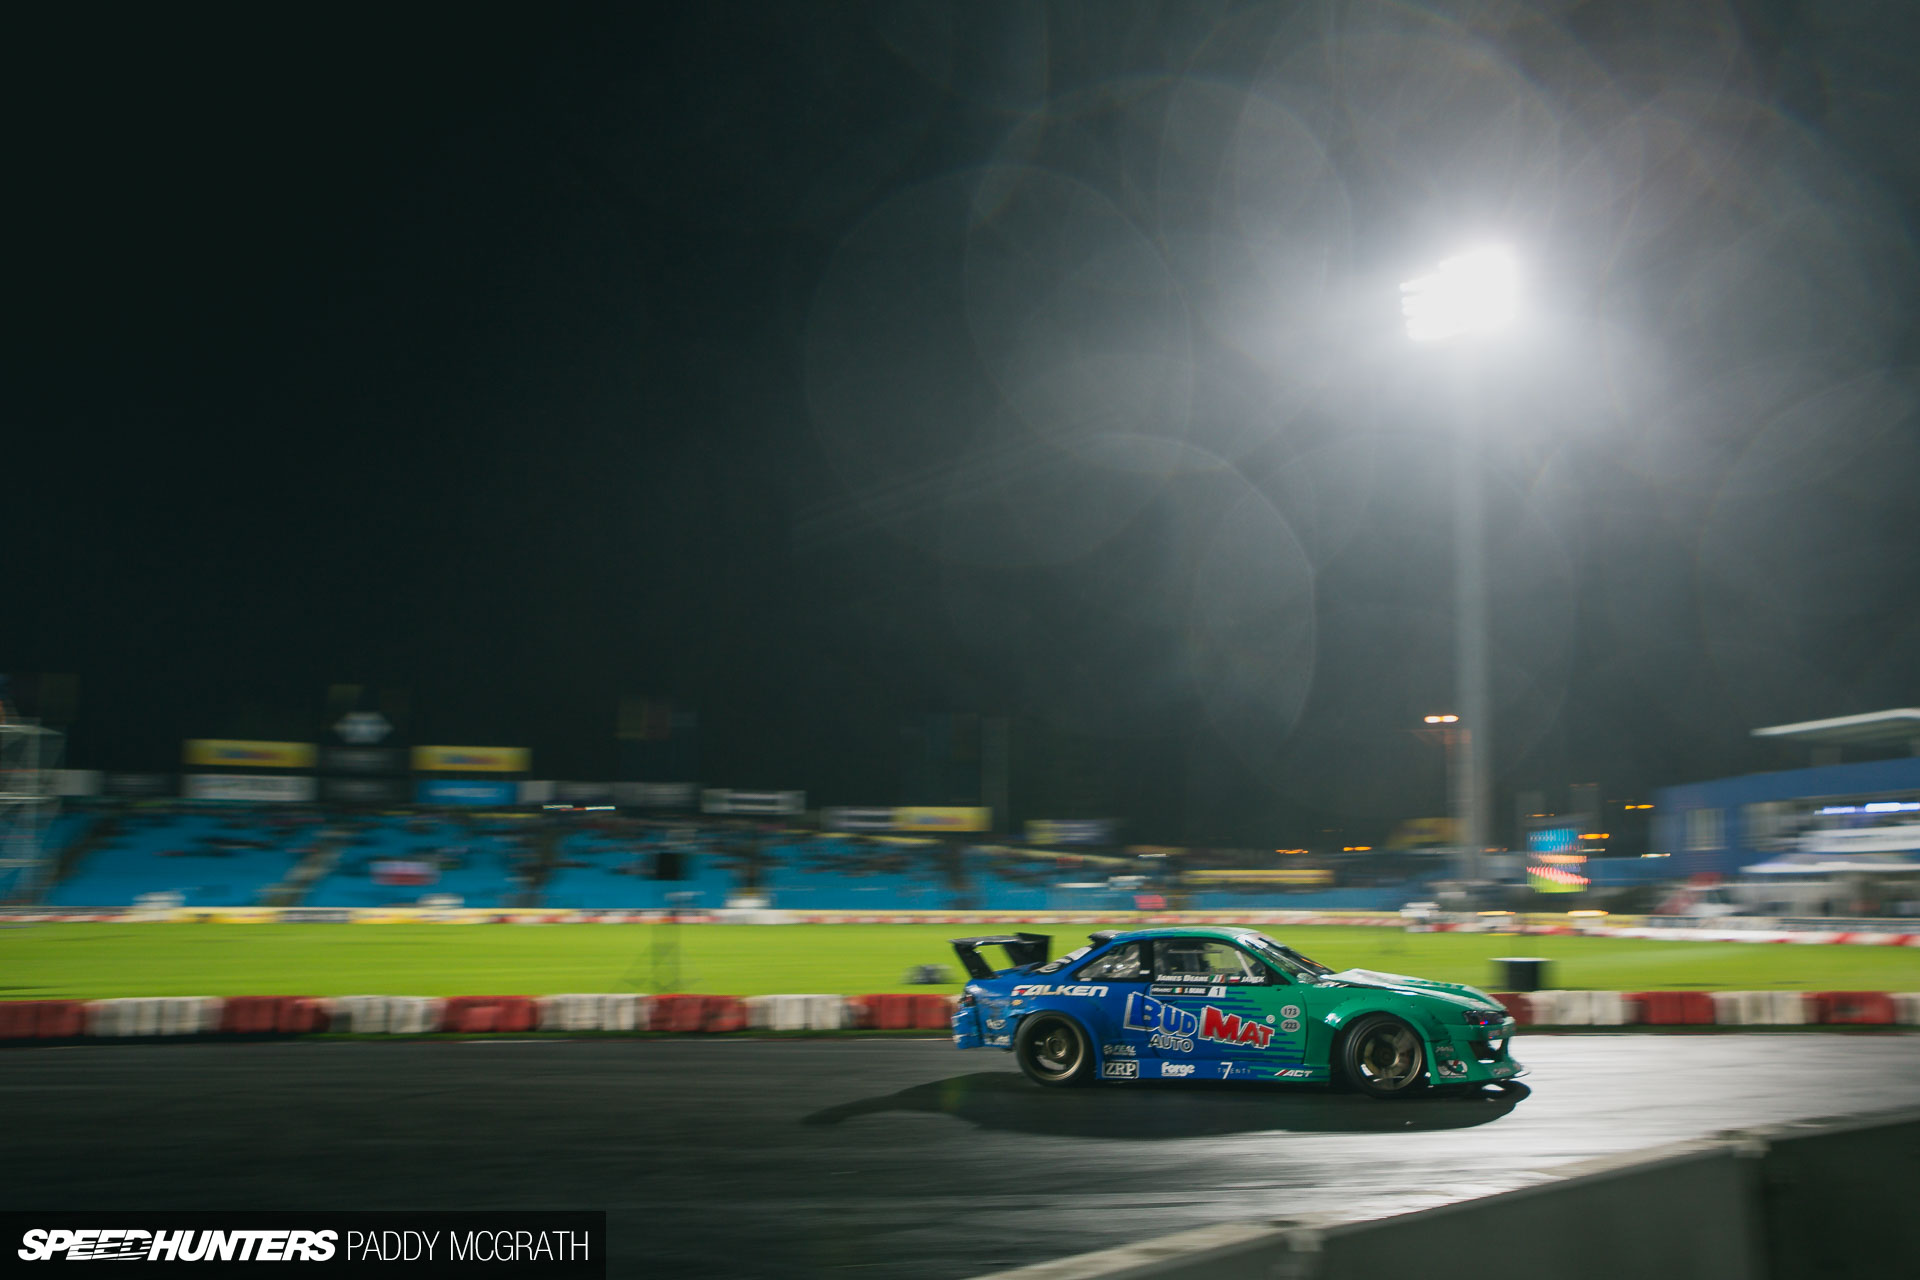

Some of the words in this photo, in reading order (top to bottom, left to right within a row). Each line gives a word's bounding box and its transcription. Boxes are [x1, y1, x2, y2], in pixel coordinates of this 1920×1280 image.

[1011, 984, 1109, 997] FALKEN
[1215, 987, 1220, 996] 1
[1284, 1008, 1297, 1016] 173
[1284, 1022, 1297, 1030] 223
[1148, 1034, 1195, 1053] AUTO
[1106, 1062, 1137, 1076] ZRP
[1284, 1069, 1313, 1077] ACT
